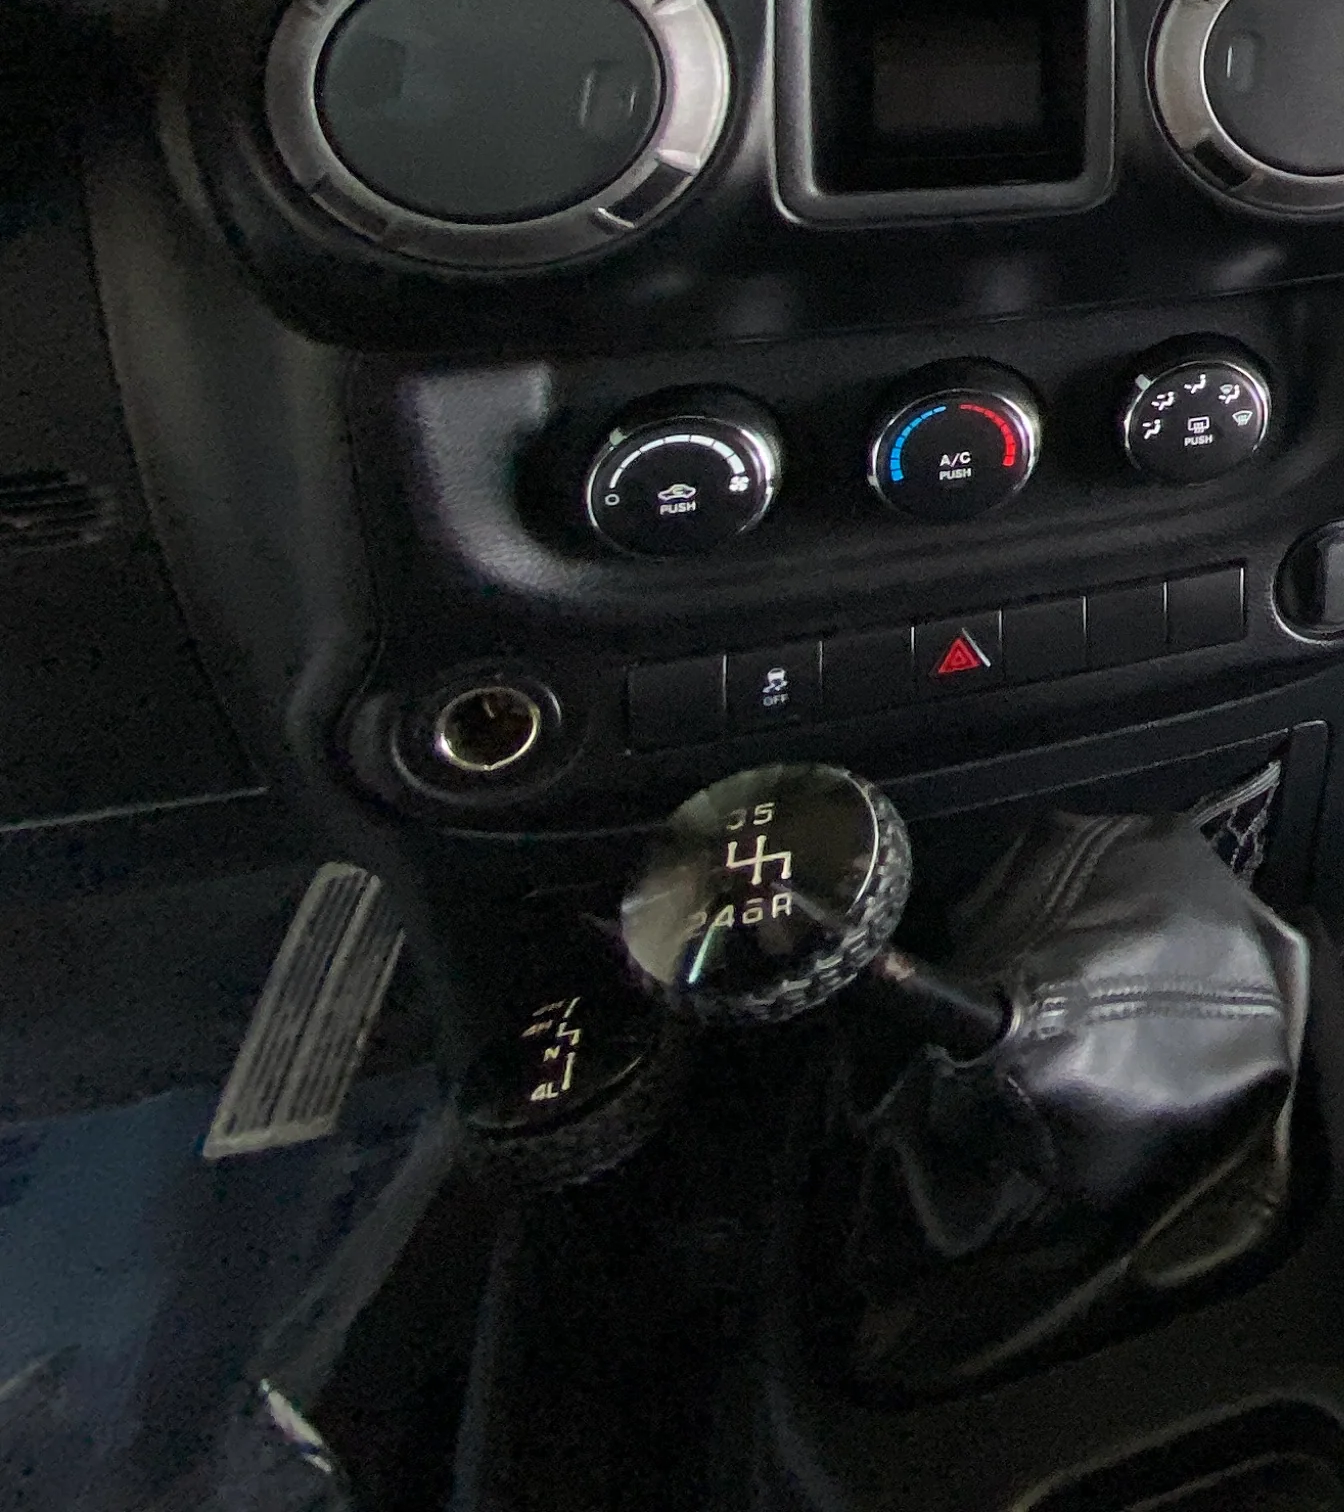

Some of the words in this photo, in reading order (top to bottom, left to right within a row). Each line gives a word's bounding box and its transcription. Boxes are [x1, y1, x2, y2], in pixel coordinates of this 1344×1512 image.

[1184, 434, 1213, 446] PUSH
[940, 451, 971, 467] A/C
[939, 468, 972, 480] PUSH
[659, 501, 696, 515] PUSH
[763, 693, 789, 706] OFF
[753, 802, 775, 825] 5
[543, 1045, 560, 1062] N
[530, 1082, 559, 1101] 4L
